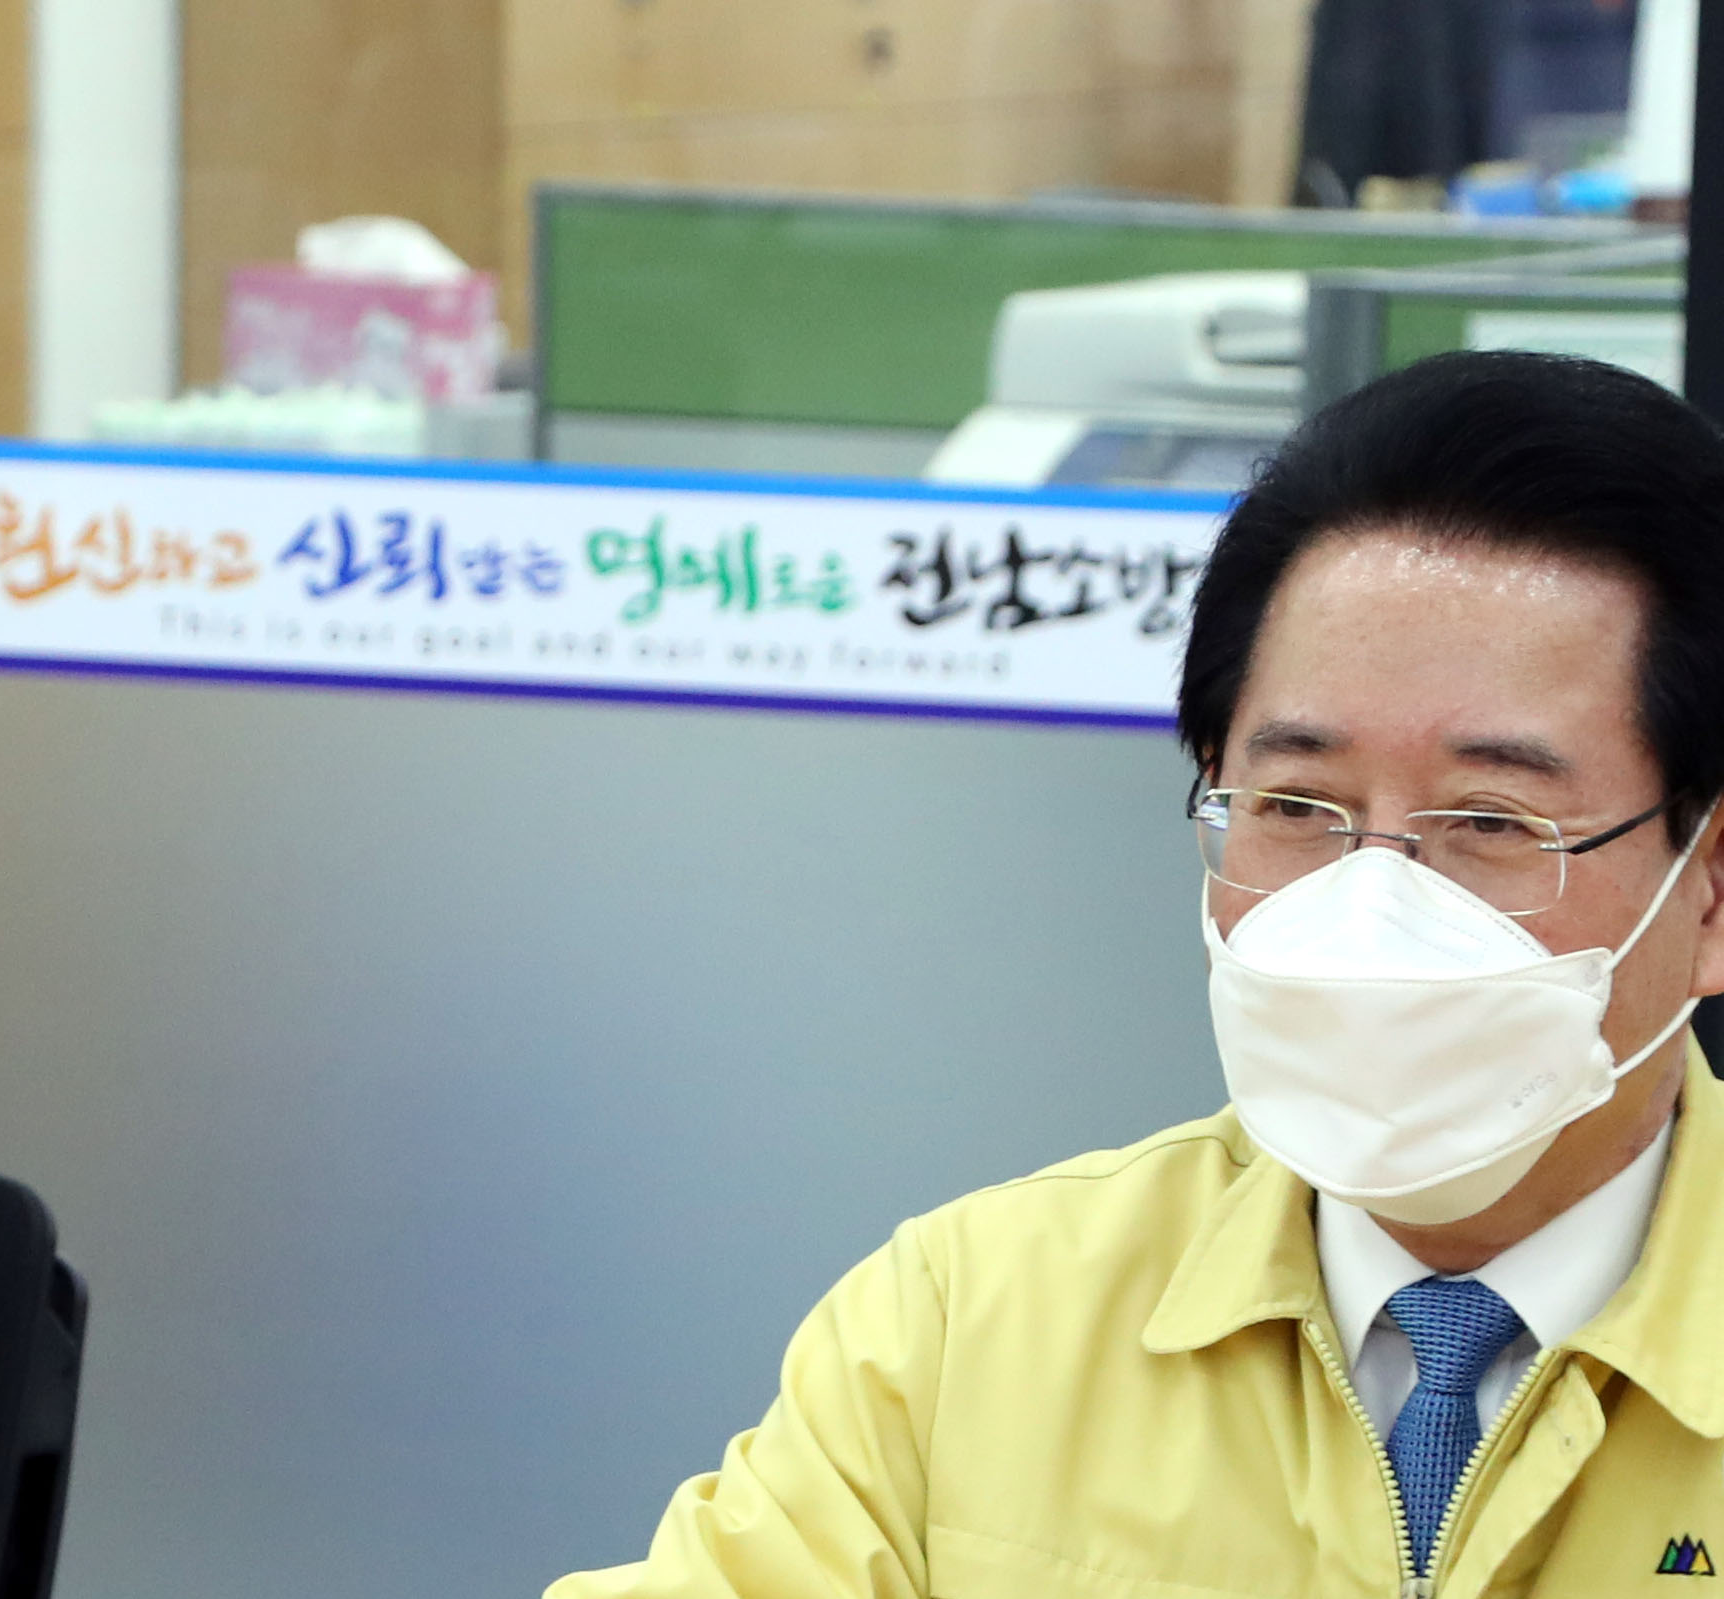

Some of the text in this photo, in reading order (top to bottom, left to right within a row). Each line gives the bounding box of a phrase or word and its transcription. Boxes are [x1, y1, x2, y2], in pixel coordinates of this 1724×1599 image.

[277, 508, 564, 600] 신뢰받는
[585, 518, 851, 621] 명예로운
[321, 619, 394, 651] our
[413, 619, 516, 660] goal
